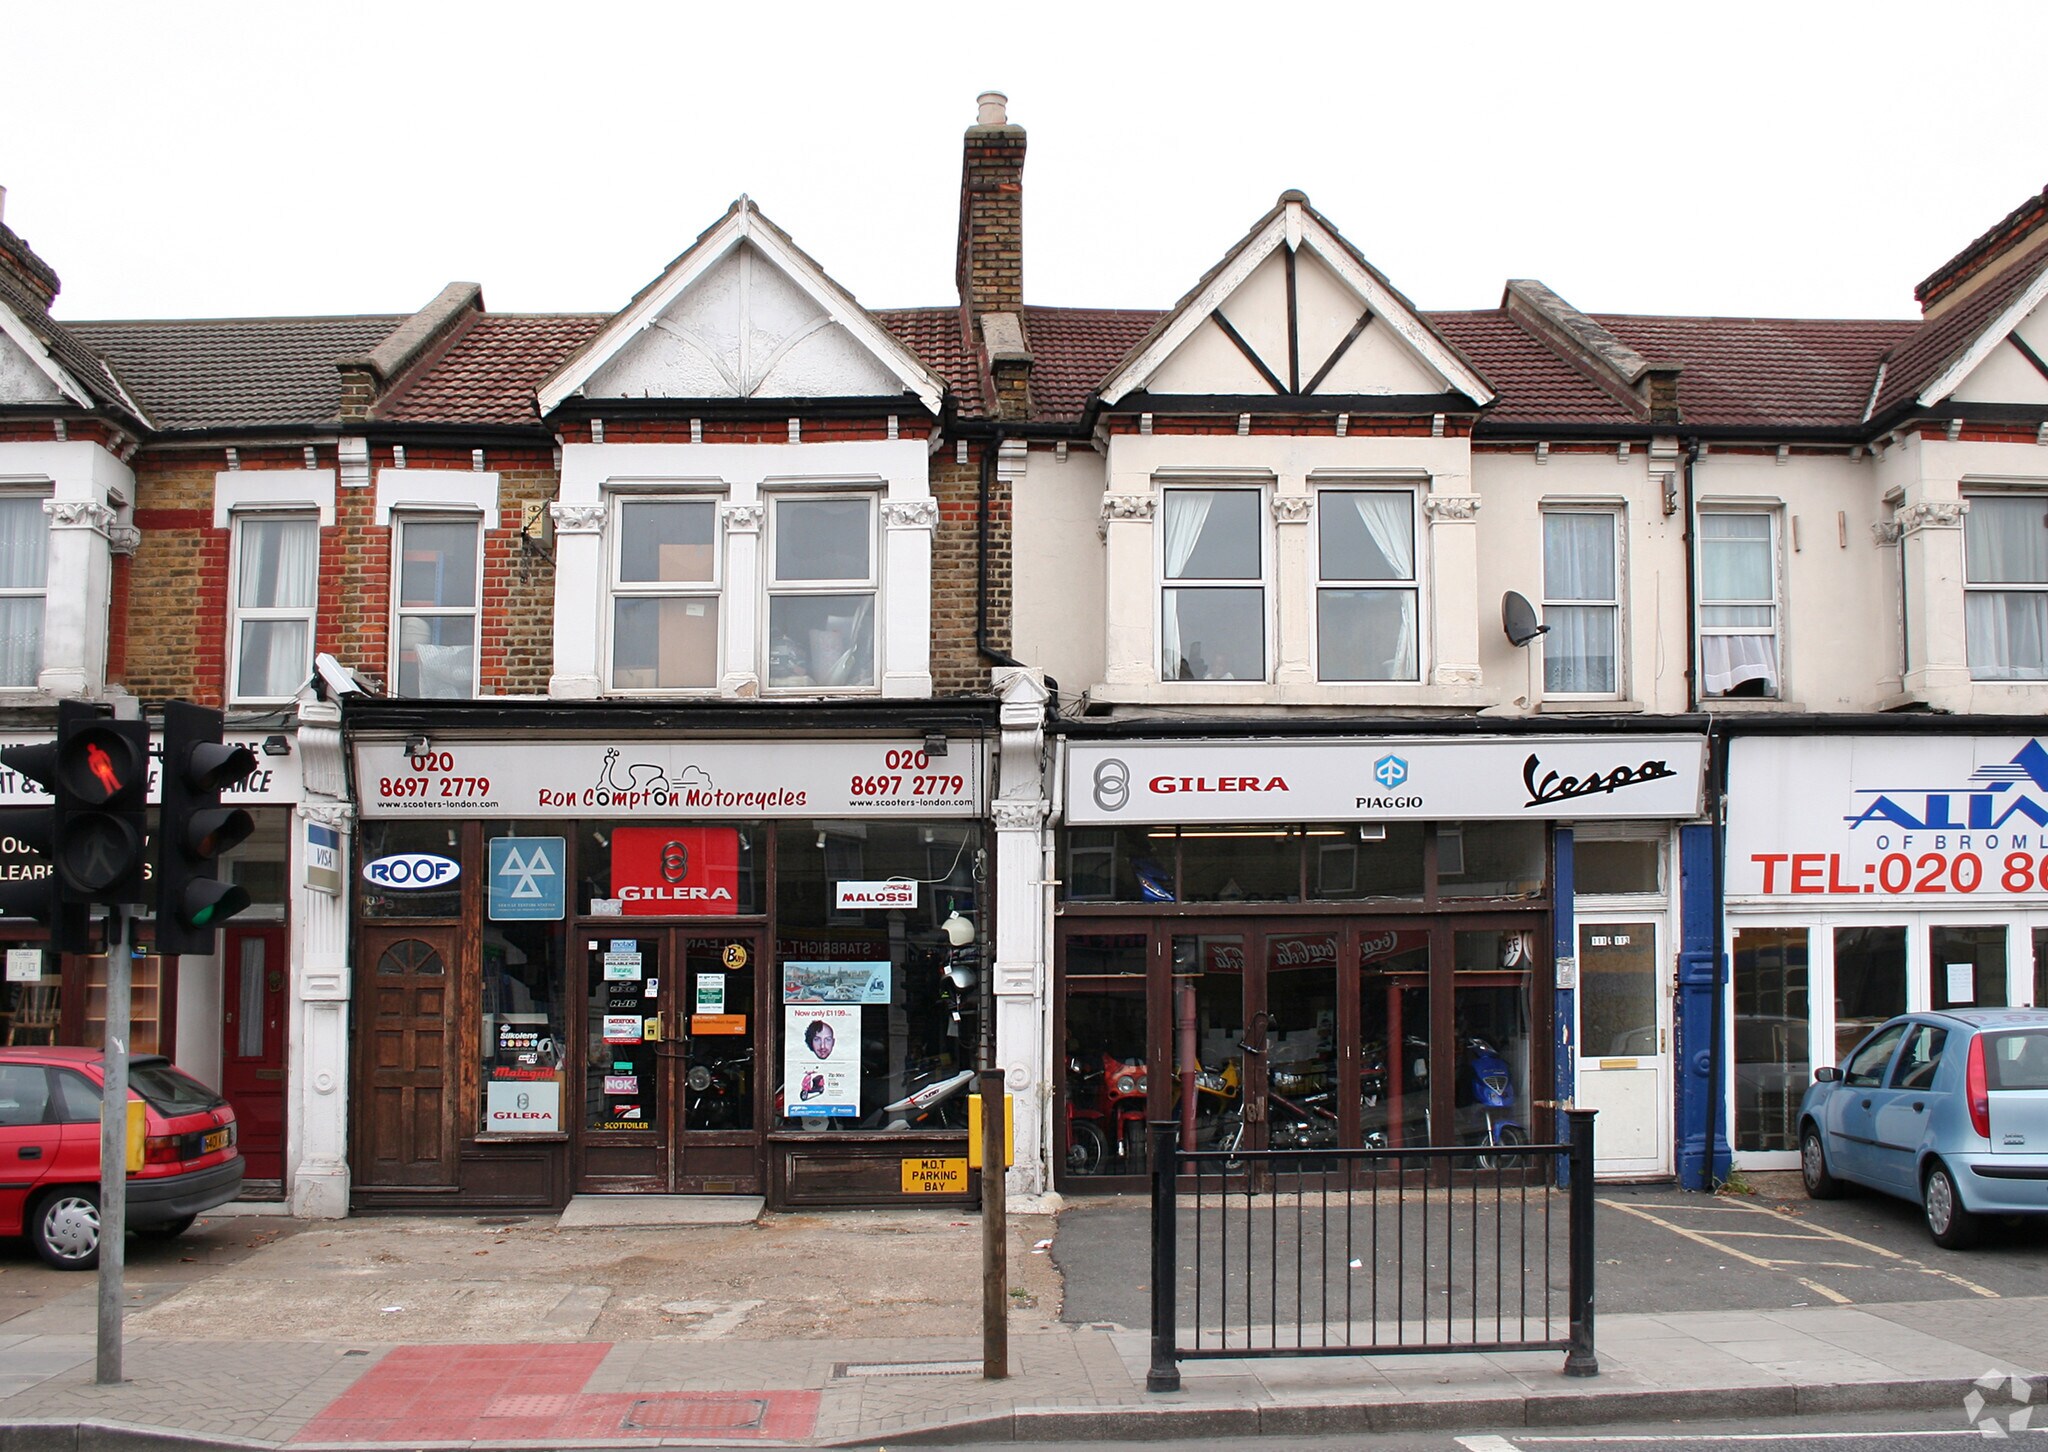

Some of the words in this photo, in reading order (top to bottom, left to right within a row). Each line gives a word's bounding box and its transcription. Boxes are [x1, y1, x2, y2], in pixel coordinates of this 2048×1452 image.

[411, 752, 454, 772] 020
[885, 750, 929, 770] 020
[380, 777, 429, 797] 8697
[440, 777, 490, 797] 2779
[851, 775, 902, 795] 8697
[912, 775, 963, 795] 2779
[1149, 776, 1289, 794] GILERA
[1523, 753, 1677, 808] Vespa
[377, 800, 499, 808] www.scooters-london.com
[538, 788, 577, 806] Ron
[582, 787, 679, 809] Compton
[686, 787, 807, 810] Motorcycles
[849, 798, 973, 806] www.scooters-london.com
[1355, 796, 1423, 808] PIAGGIO
[1876, 834, 1913, 850] OF
[316, 847, 333, 868] VISA
[371, 859, 451, 883] ROOF
[2001, 852, 2048, 894] 8
[617, 886, 732, 901] GILERA
[842, 893, 912, 902] MALOSSI
[794, 1009, 810, 1017] Now
[811, 1009, 825, 1018] only
[500, 1032, 538, 1040] Silkolene
[606, 1080, 632, 1090] NGK
[493, 1112, 552, 1120] GILERA
[604, 1121, 649, 1129] SCOTTOILER
[912, 1171, 957, 1180] PARKING
[924, 1182, 946, 1191] BAY
